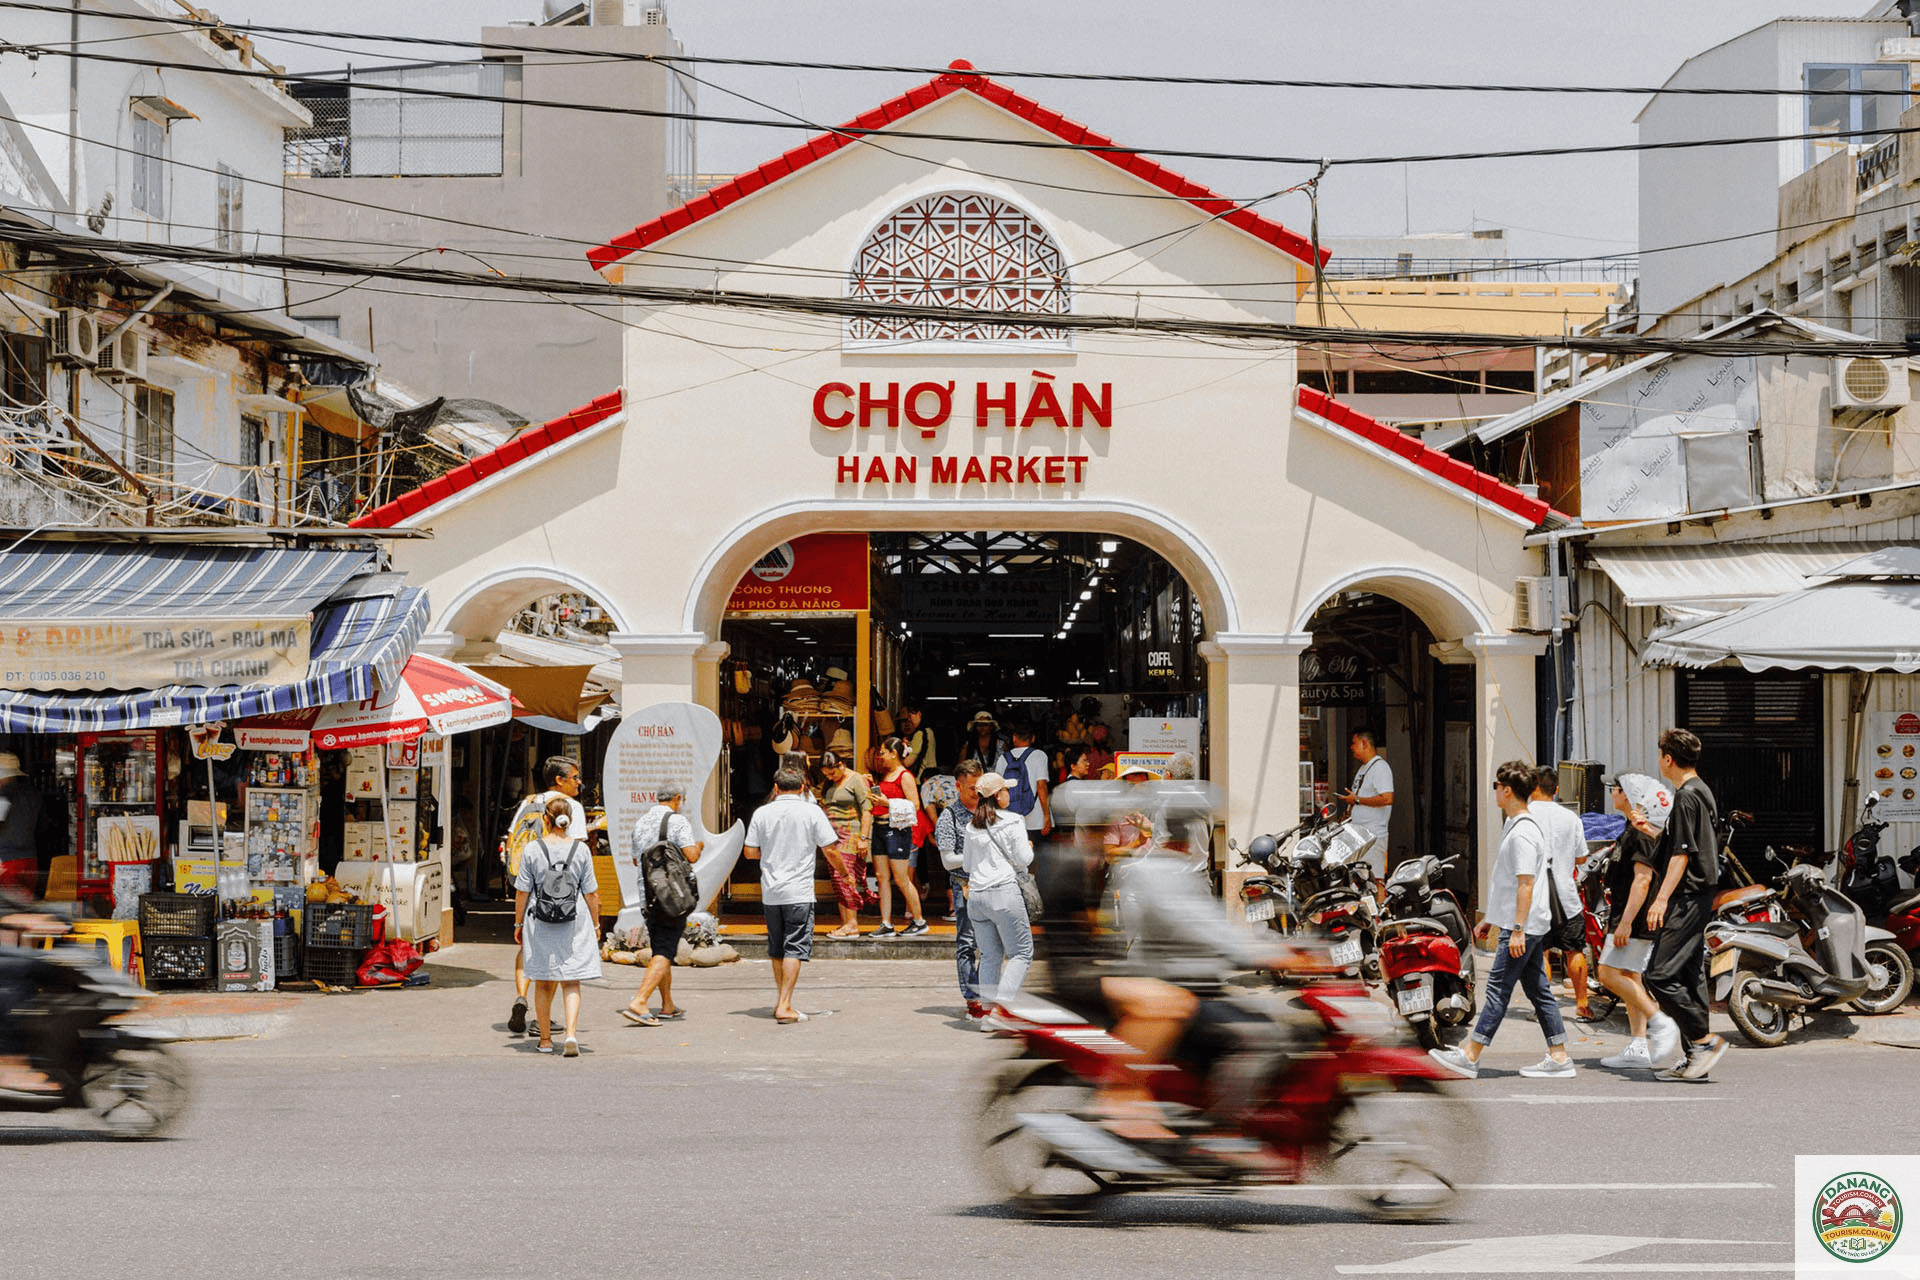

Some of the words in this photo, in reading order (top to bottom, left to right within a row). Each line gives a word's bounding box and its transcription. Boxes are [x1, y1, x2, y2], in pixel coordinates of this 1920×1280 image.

[813, 380, 955, 438] CHỢ
[976, 370, 1112, 427] HÀN
[838, 456, 917, 484] HAN
[932, 456, 1089, 484] MARKET
[734, 584, 773, 595] CÔNG
[778, 584, 833, 595] THƯƠNG
[748, 597, 777, 609] PHỐ
[779, 598, 798, 609] ĐÀ
[46, 624, 132, 656] DRINK
[143, 629, 175, 648] TRÀ
[181, 628, 215, 648] SỮA
[232, 630, 265, 648] RAU
[271, 627, 298, 648] MÁ
[86, 671, 106, 681] 210
[174, 658, 205, 678] TRÀ
[211, 660, 269, 677] CHANH
[1343, 686, 1364, 701] Spa
[631, 792, 647, 803] HAN
